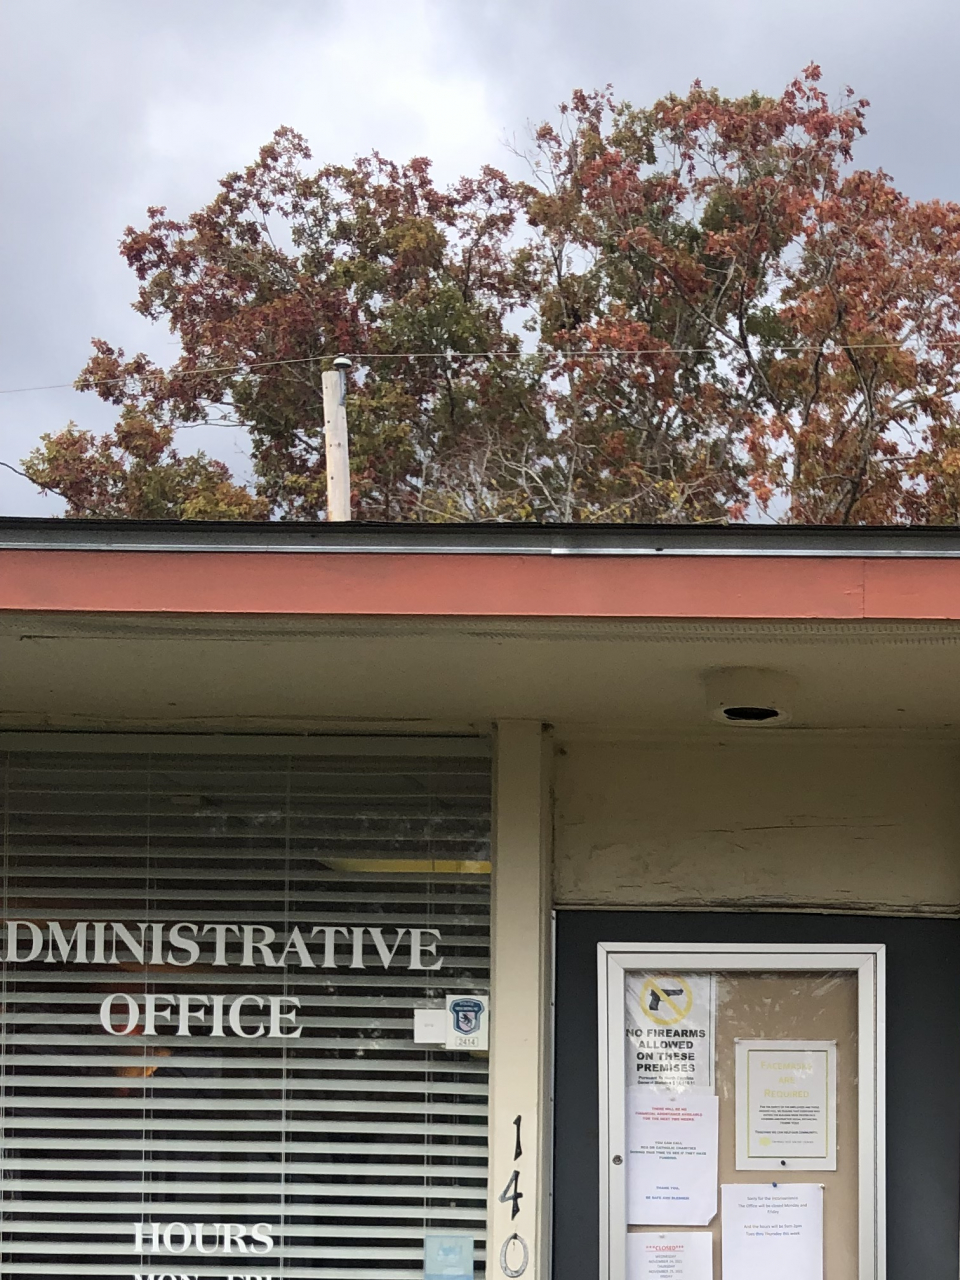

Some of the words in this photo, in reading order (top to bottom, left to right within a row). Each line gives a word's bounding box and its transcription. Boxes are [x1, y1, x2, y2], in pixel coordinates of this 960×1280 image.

[0, 921, 443, 970] DMINISTRATIVE
[100, 993, 302, 1038] OFFICE
[625, 1029, 643, 1037] NO
[647, 1029, 706, 1038] FIREARMS
[458, 1038, 475, 1046] 2414
[638, 1040, 694, 1049] ALLOWED
[636, 1052, 654, 1060] ON
[657, 1052, 695, 1061] THESE
[636, 1063, 695, 1072] PREMISES
[134, 1222, 274, 1255] HOURS
